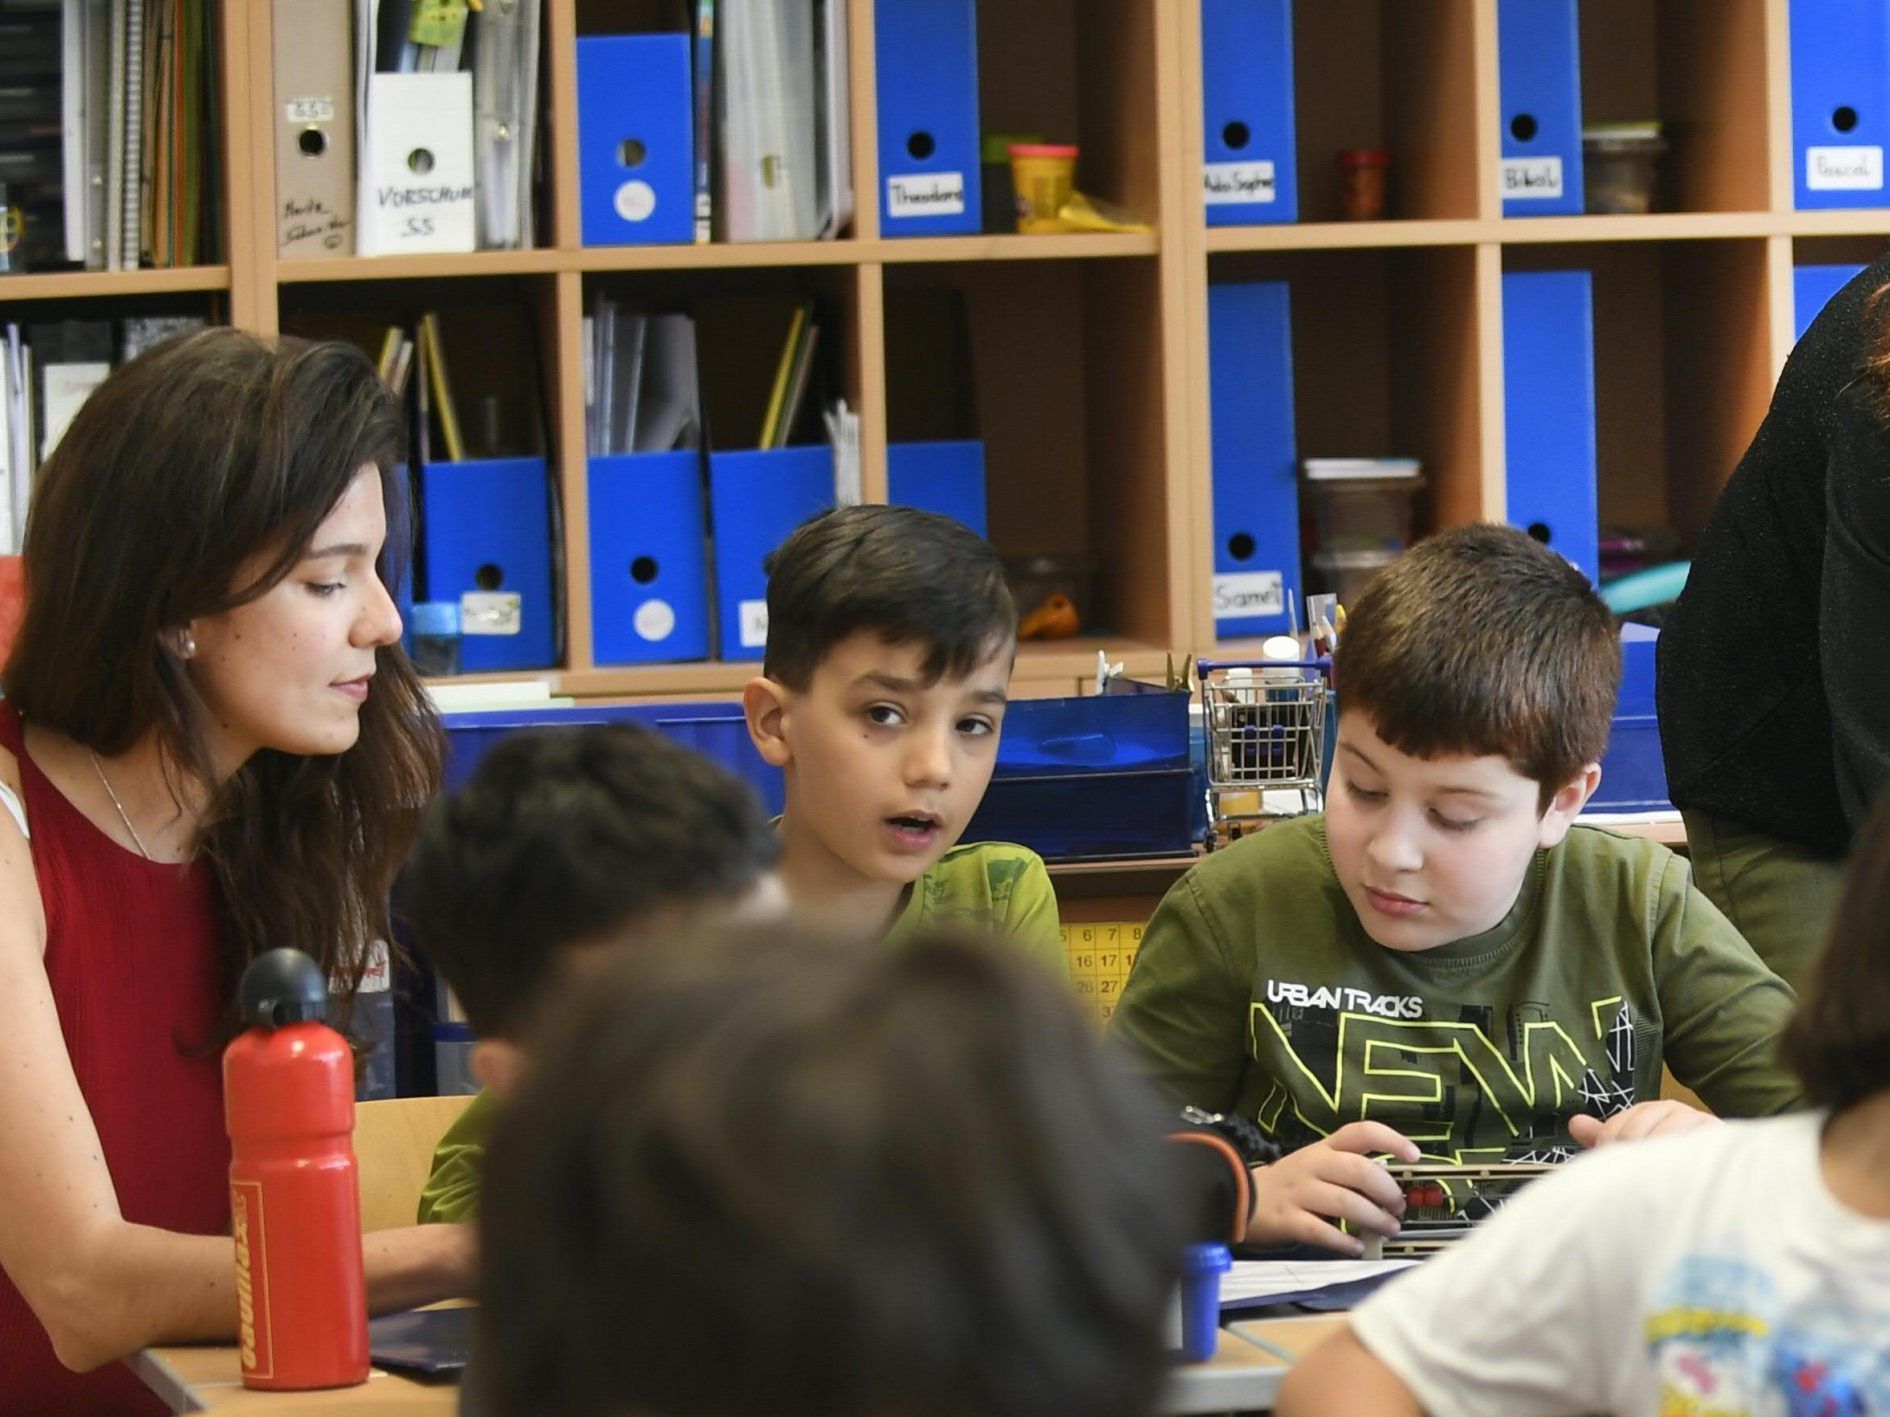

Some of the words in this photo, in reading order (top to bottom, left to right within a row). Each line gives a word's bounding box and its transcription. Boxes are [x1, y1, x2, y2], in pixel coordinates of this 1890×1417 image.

[1083, 929, 1093, 942] 6
[1108, 928, 1118, 941] 7
[1132, 927, 1142, 941] 8
[1077, 954, 1093, 968] 16
[1102, 954, 1118, 967] 17
[1101, 980, 1118, 994] 27
[1267, 979, 1343, 1010] URBAN
[1343, 987, 1424, 1019] TRACKS
